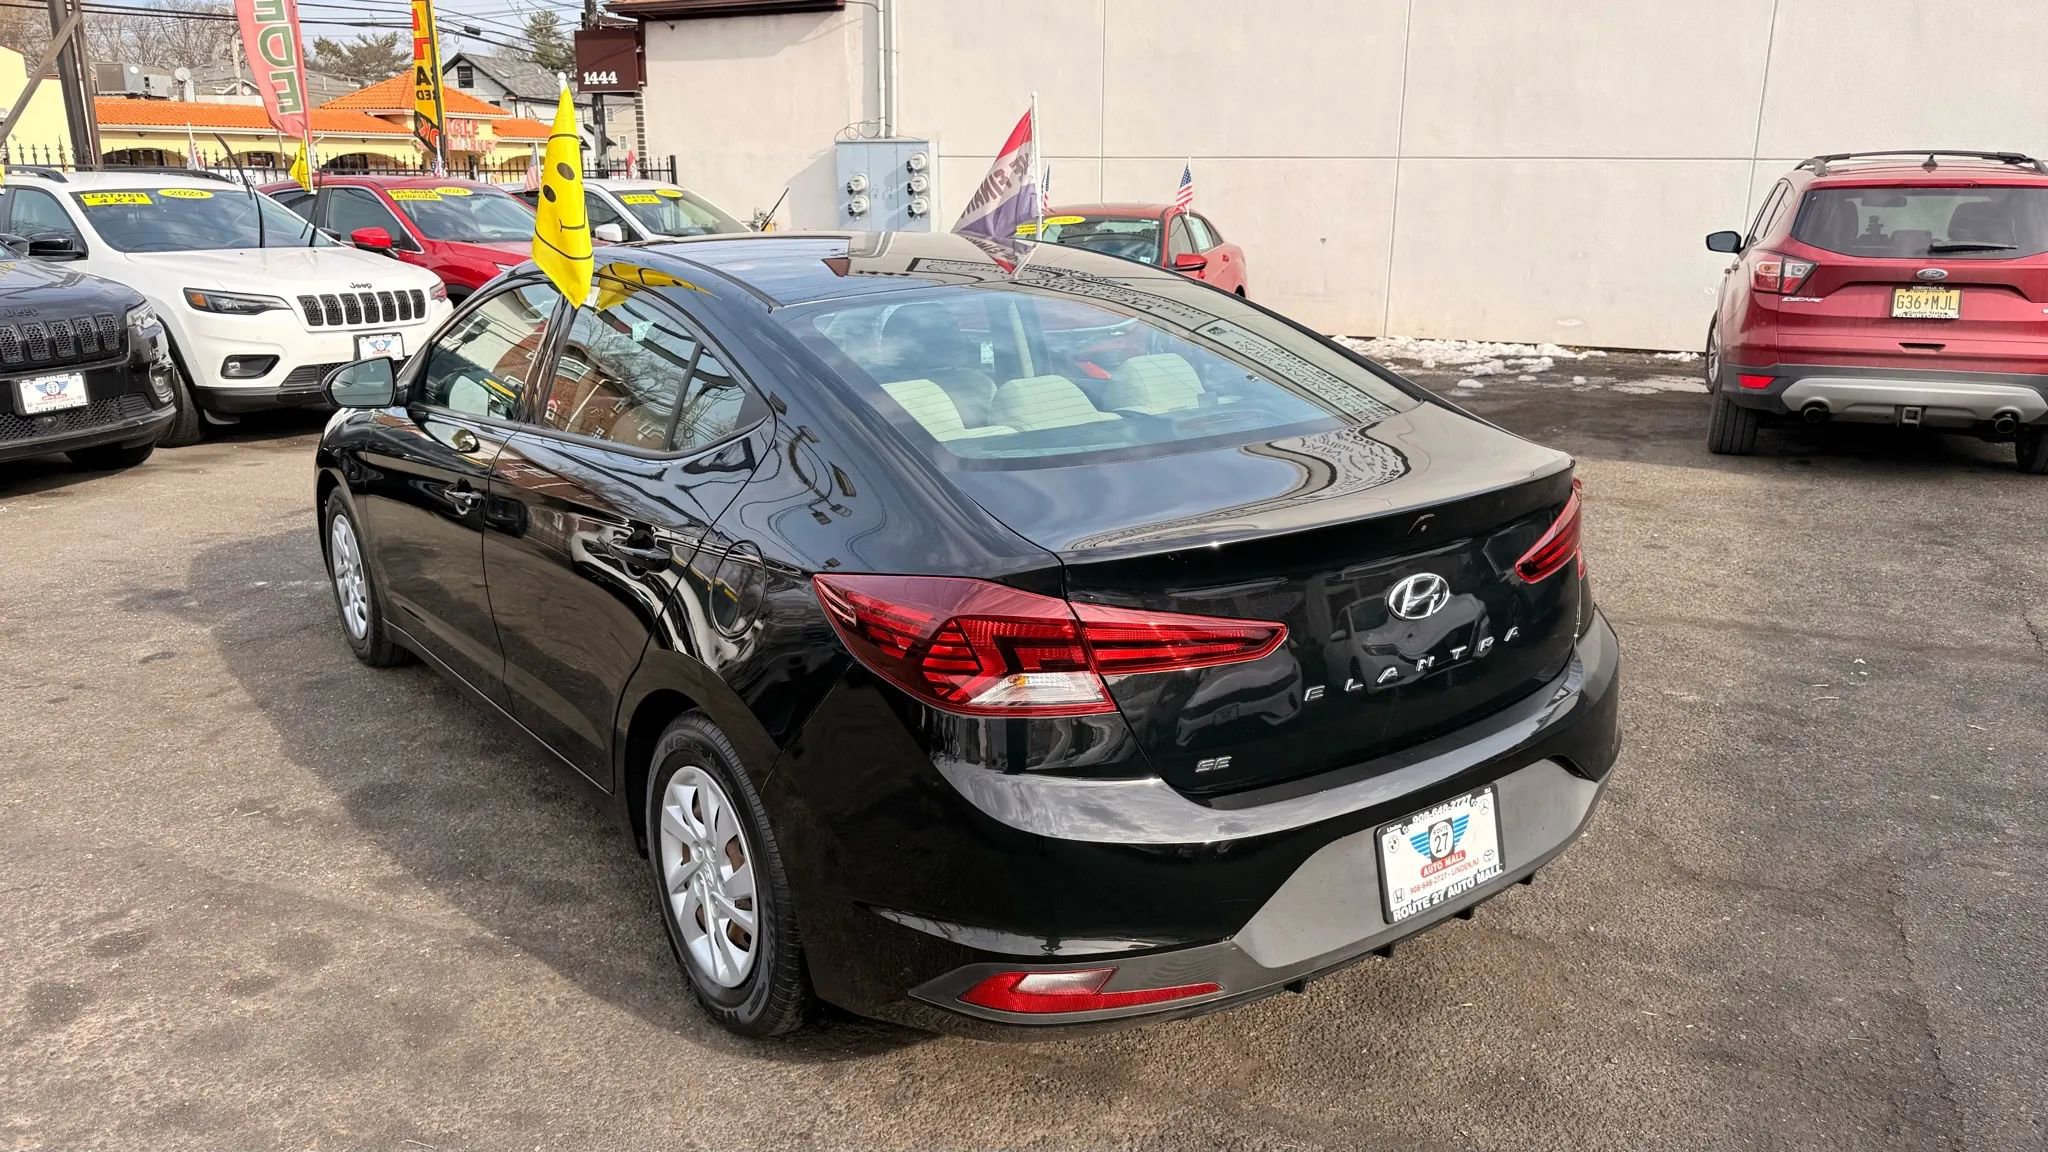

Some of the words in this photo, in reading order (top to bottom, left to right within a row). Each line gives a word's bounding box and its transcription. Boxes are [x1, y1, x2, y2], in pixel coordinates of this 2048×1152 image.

[583, 71, 618, 85] 1444
[83, 191, 146, 200] LEATHER
[349, 282, 373, 290] Jeep
[1304, 625, 1520, 703] ELANTRA
[1195, 755, 1233, 773] SE
[1433, 825, 1449, 835] ROUTE
[1434, 832, 1449, 854] 27
[1423, 861, 1444, 877] AUTO
[1445, 851, 1466, 867] MALL
[1392, 896, 1431, 922] ROUTE
[1431, 891, 1445, 905] 27
[1447, 877, 1476, 899] AUTO
[1476, 864, 1504, 885] MALL
